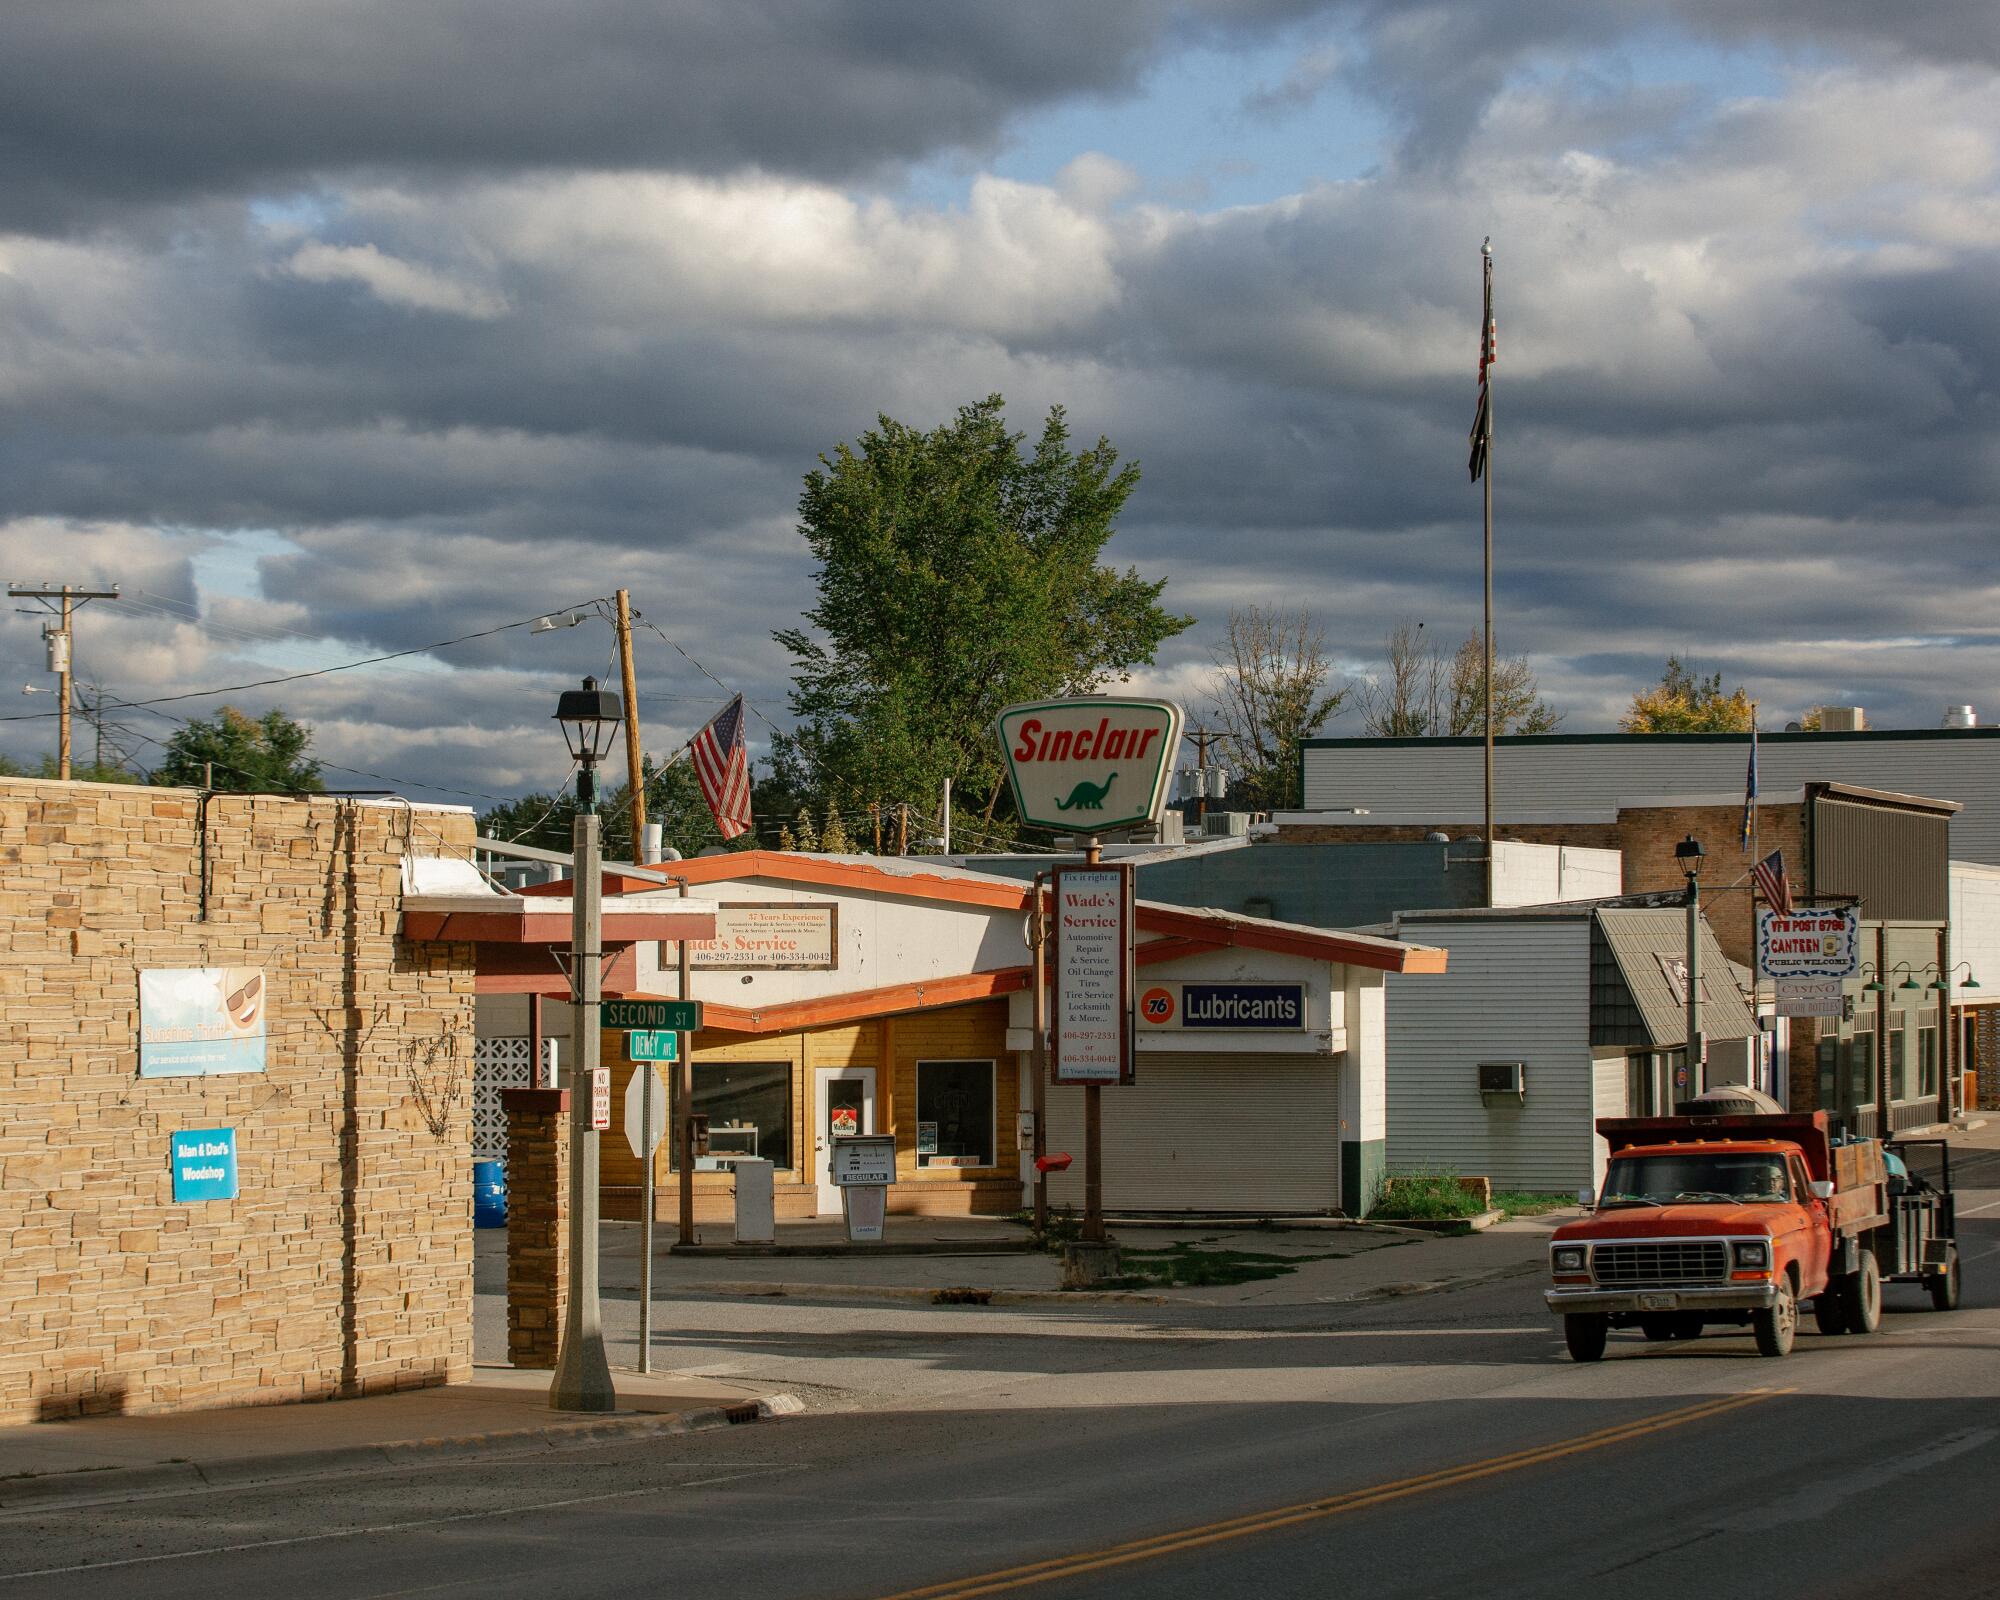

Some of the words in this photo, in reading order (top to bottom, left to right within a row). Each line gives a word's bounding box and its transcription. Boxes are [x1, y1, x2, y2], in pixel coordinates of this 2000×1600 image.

[1013, 717, 1160, 763] Sinclair
[1064, 873, 1077, 881] Fix
[1088, 873, 1108, 883] right
[1109, 873, 1117, 881] at
[1064, 892, 1116, 907] Wade's
[760, 913, 780, 921] Years
[782, 913, 825, 923] Experience
[1063, 914, 1117, 928] Service
[1792, 920, 1816, 932] POST
[1066, 933, 1113, 941] Automotive
[734, 934, 798, 951] Service
[1770, 938, 1820, 953] CANTEEN
[1076, 944, 1104, 954] Repair
[694, 952, 754, 961] 406-297-2331
[758, 953, 767, 961] or
[770, 952, 830, 961] 406-334-0042
[1070, 956, 1078, 964] &
[1080, 956, 1110, 964] Service
[1803, 958, 1849, 966] WELCOME
[1067, 968, 1081, 976] Oil
[1083, 968, 1114, 977] Change
[1079, 980, 1100, 988] Tires
[1782, 984, 1835, 993] CASINO
[1064, 991, 1083, 999] Tire
[1084, 991, 1114, 999] Service
[1068, 1003, 1111, 1011] Locksmith
[1147, 997, 1168, 1015] 76
[1187, 993, 1296, 1020] Lubricants
[609, 1004, 666, 1025] SECOND
[675, 1012, 687, 1026] ST
[144, 1024, 194, 1042] Sunshine
[1063, 1032, 1116, 1040] 406-297-2331
[635, 1034, 659, 1056] DEWEY
[662, 1042, 672, 1056] AVE
[1063, 1055, 1117, 1063] 406-334-0042
[598, 1072, 606, 1084] NO
[178, 1144, 197, 1158] Alan
[198, 1144, 204, 1156] &
[206, 1142, 228, 1156] Dad's
[182, 1166, 225, 1181] Woodshop
[846, 1173, 885, 1181] REGULAR
